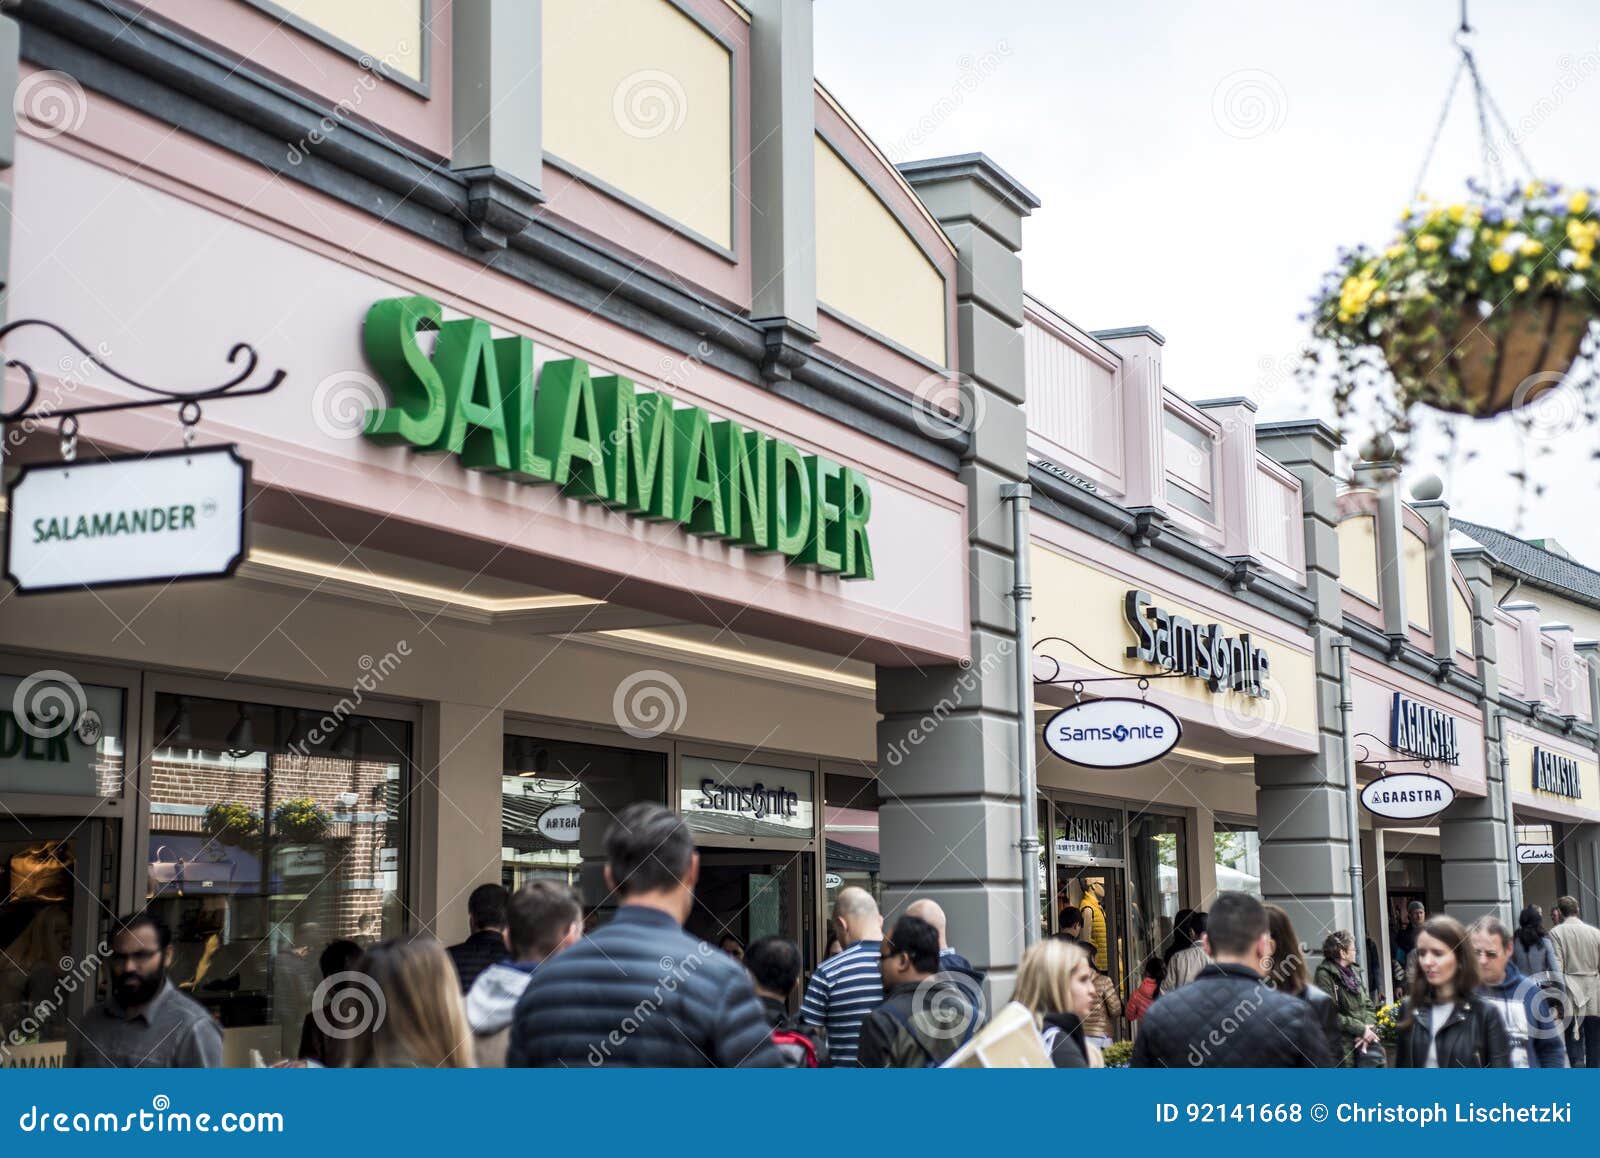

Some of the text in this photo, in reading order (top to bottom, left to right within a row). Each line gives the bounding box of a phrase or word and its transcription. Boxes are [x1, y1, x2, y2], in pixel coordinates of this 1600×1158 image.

[363, 295, 875, 581] SALAMANDER
[33, 504, 196, 544] SALAMANDER
[1124, 589, 1271, 701] Samsonite
[1060, 724, 1164, 742] Samsonite
[700, 779, 798, 818] Samsonite
[1521, 849, 1553, 859] Clarks
